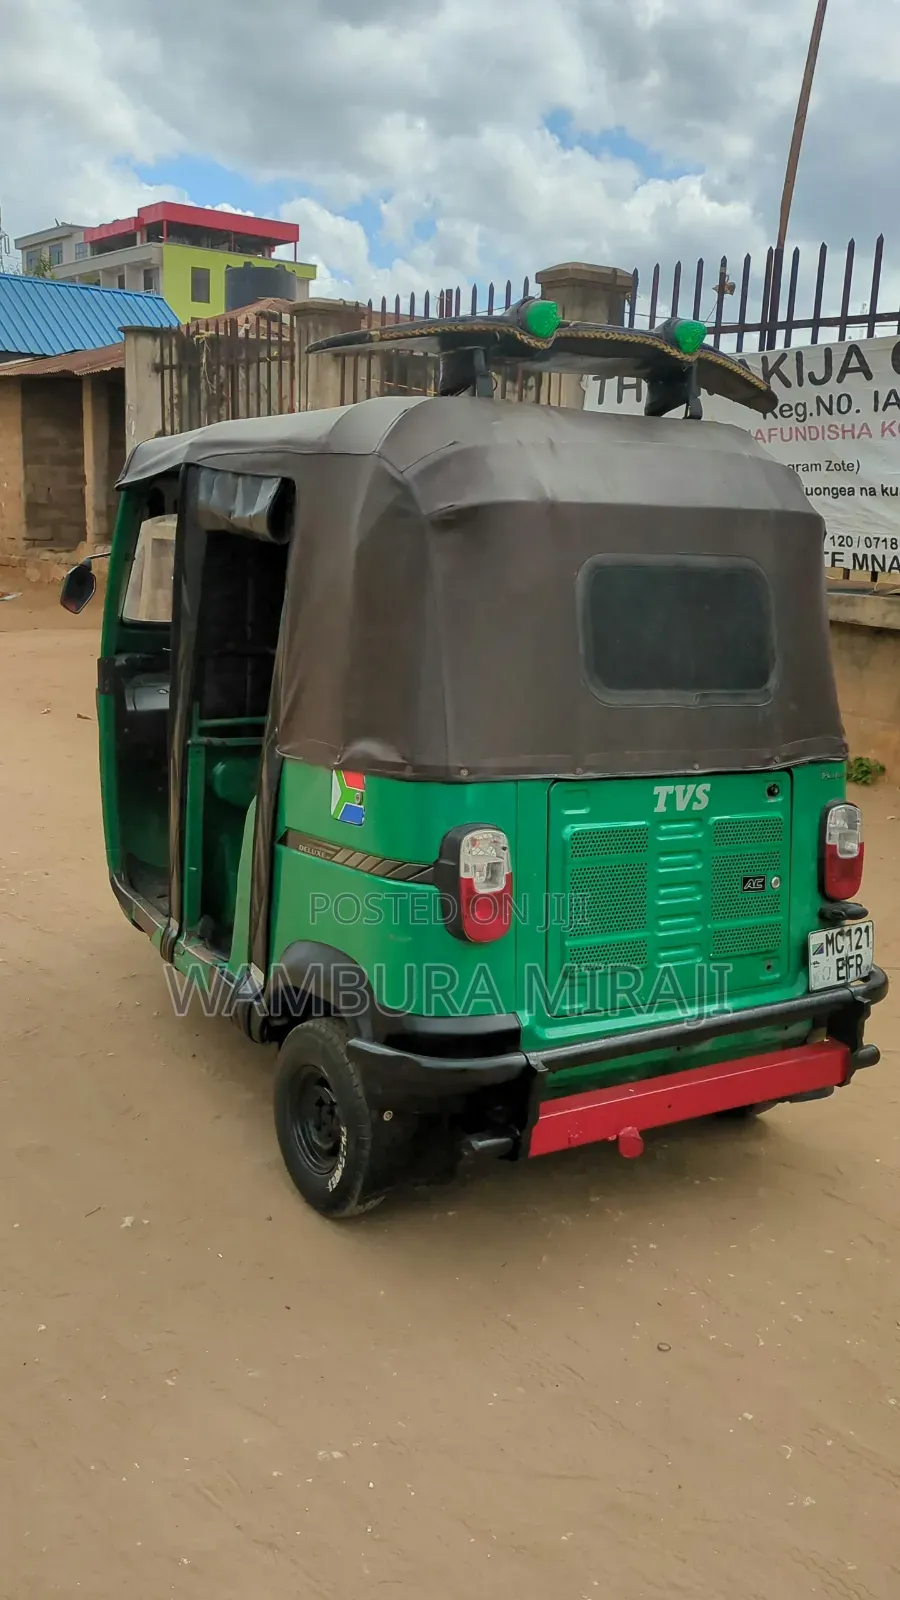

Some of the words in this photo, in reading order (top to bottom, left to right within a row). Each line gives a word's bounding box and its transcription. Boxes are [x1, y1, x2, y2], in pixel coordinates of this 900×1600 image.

[749, 422, 872, 444] AFUNDISHA
[880, 420, 900, 438] K
[825, 460, 860, 474] Zote)
[860, 486, 876, 497] na
[881, 484, 900, 497] ku
[864, 537, 899, 550] 0718
[653, 784, 711, 812] TVS
[299, 844, 326, 858] DELUXE
[743, 877, 764, 890] AC
